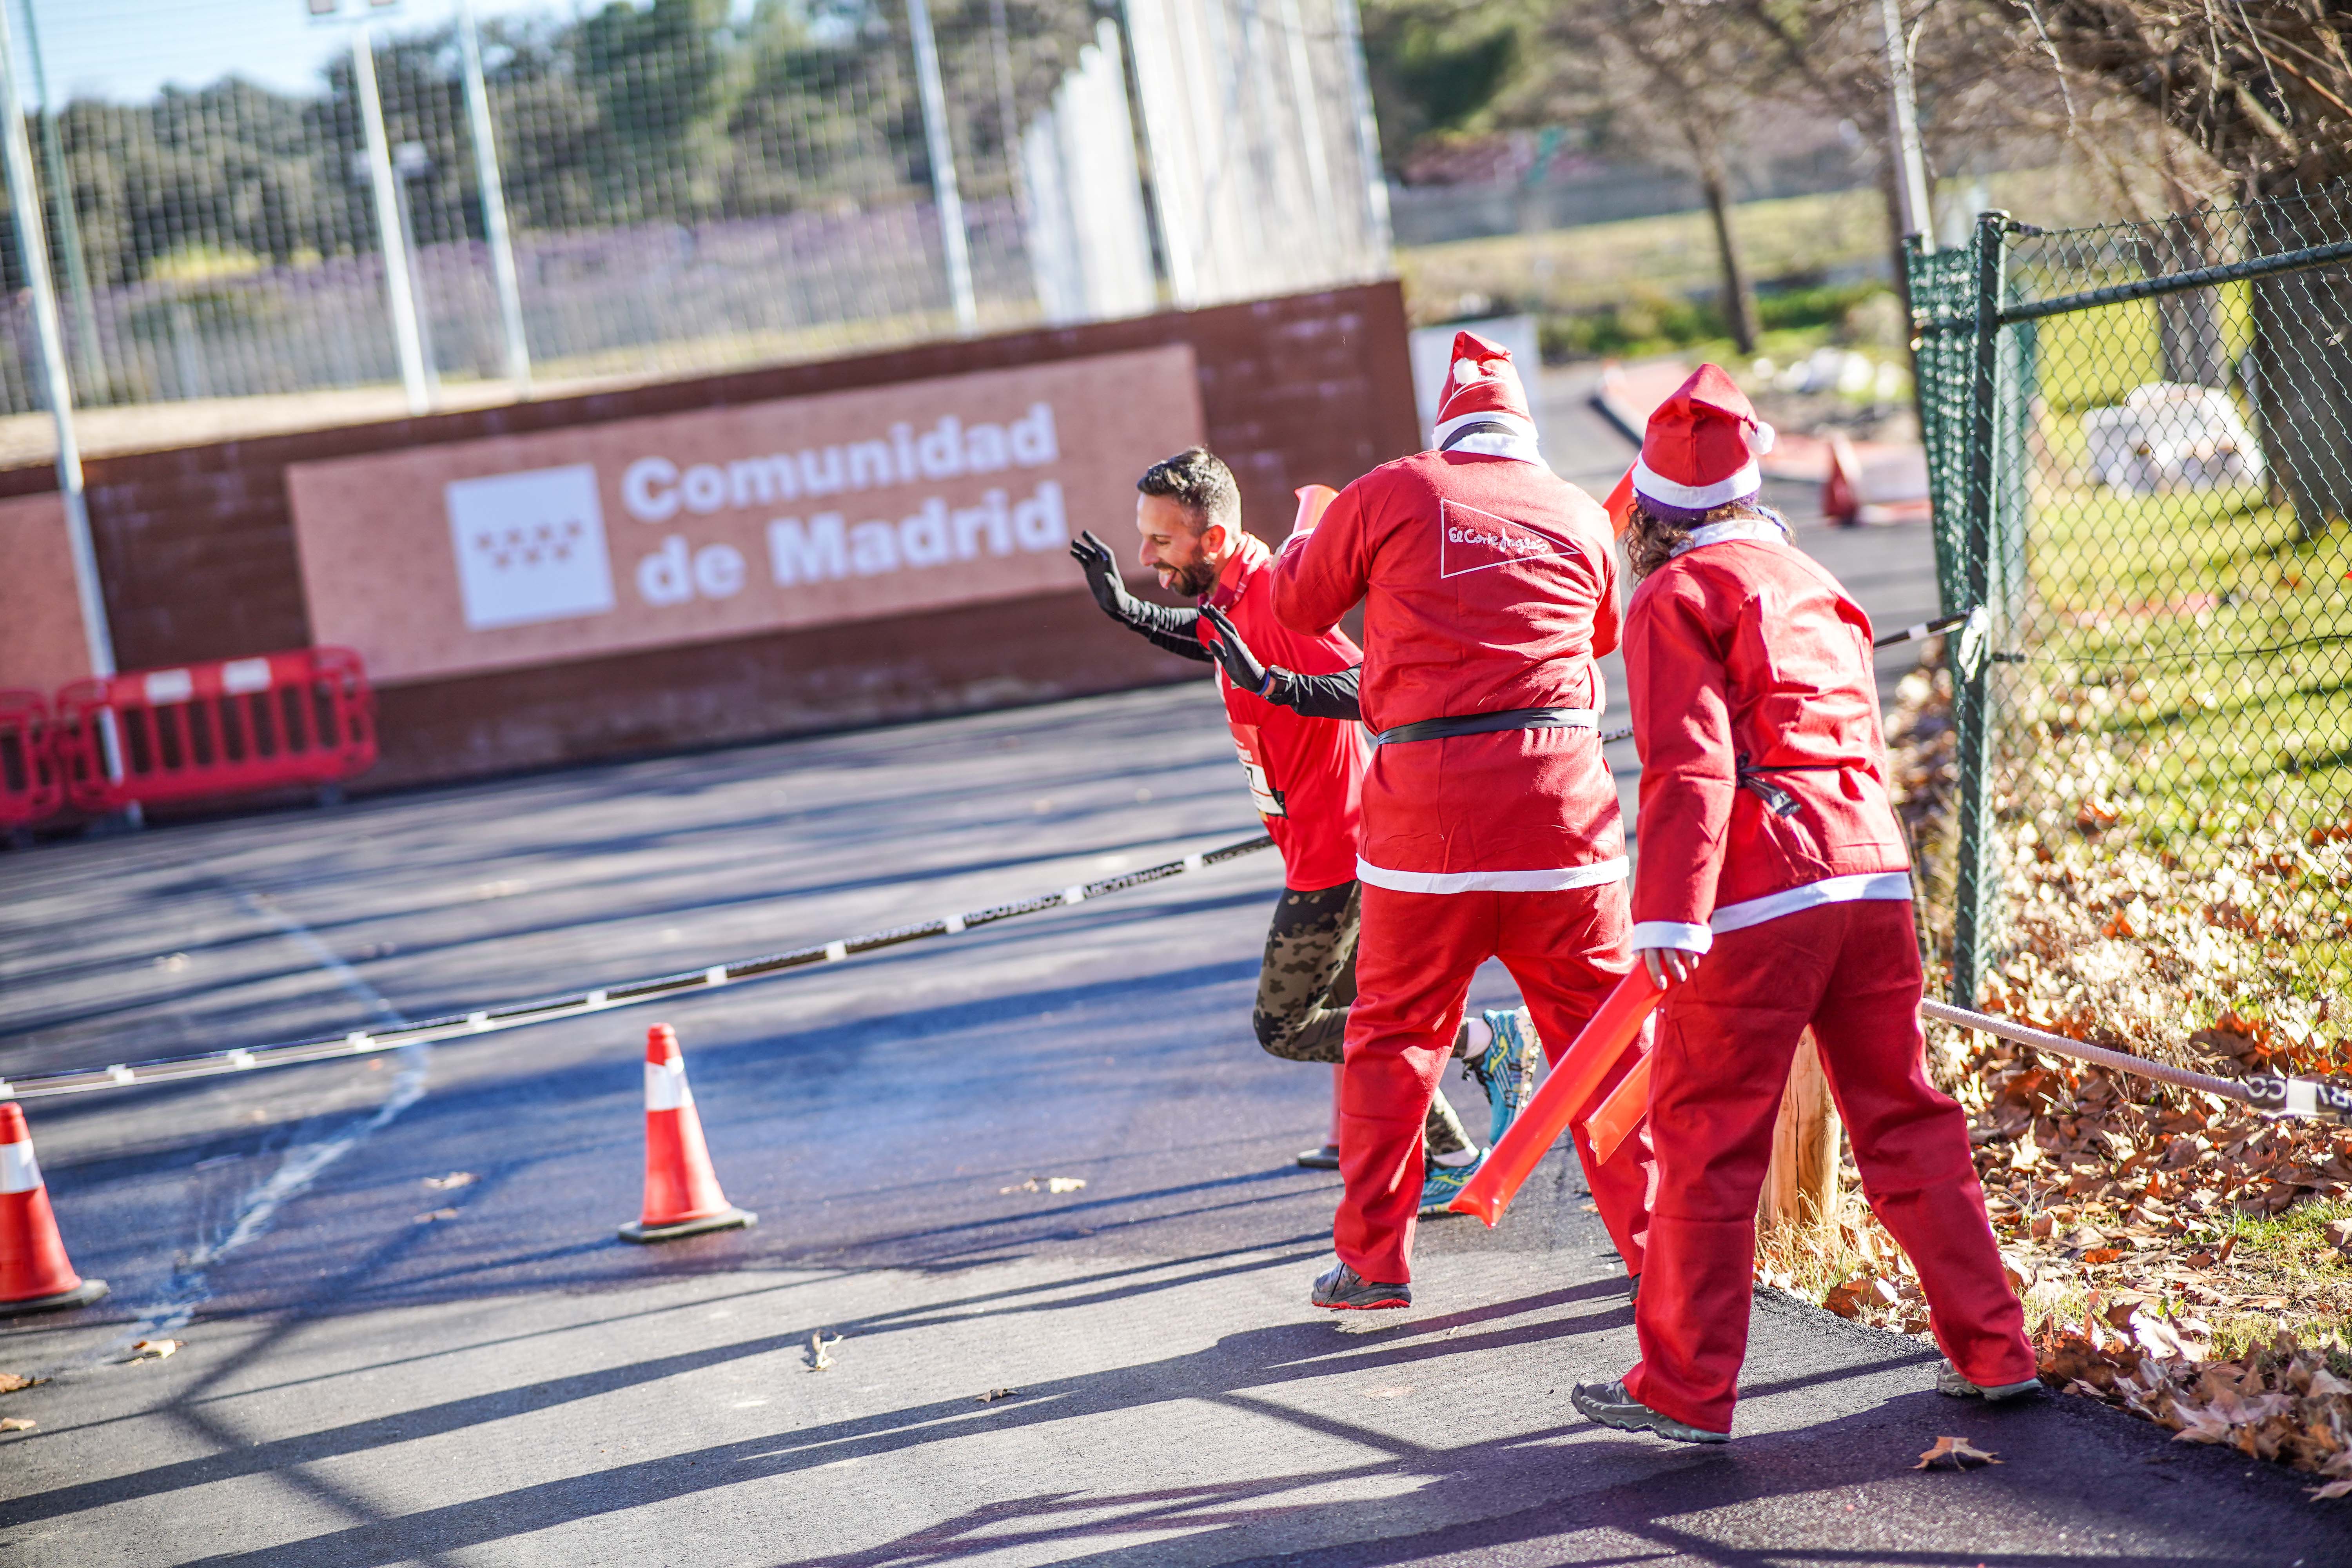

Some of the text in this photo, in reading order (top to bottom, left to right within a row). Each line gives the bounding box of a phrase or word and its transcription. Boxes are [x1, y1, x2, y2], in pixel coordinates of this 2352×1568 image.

[622, 402, 1060, 521] Comunidad
[636, 480, 1069, 606] de Madrid
[1448, 527, 1464, 543] El
[1464, 529, 1498, 545] Corte
